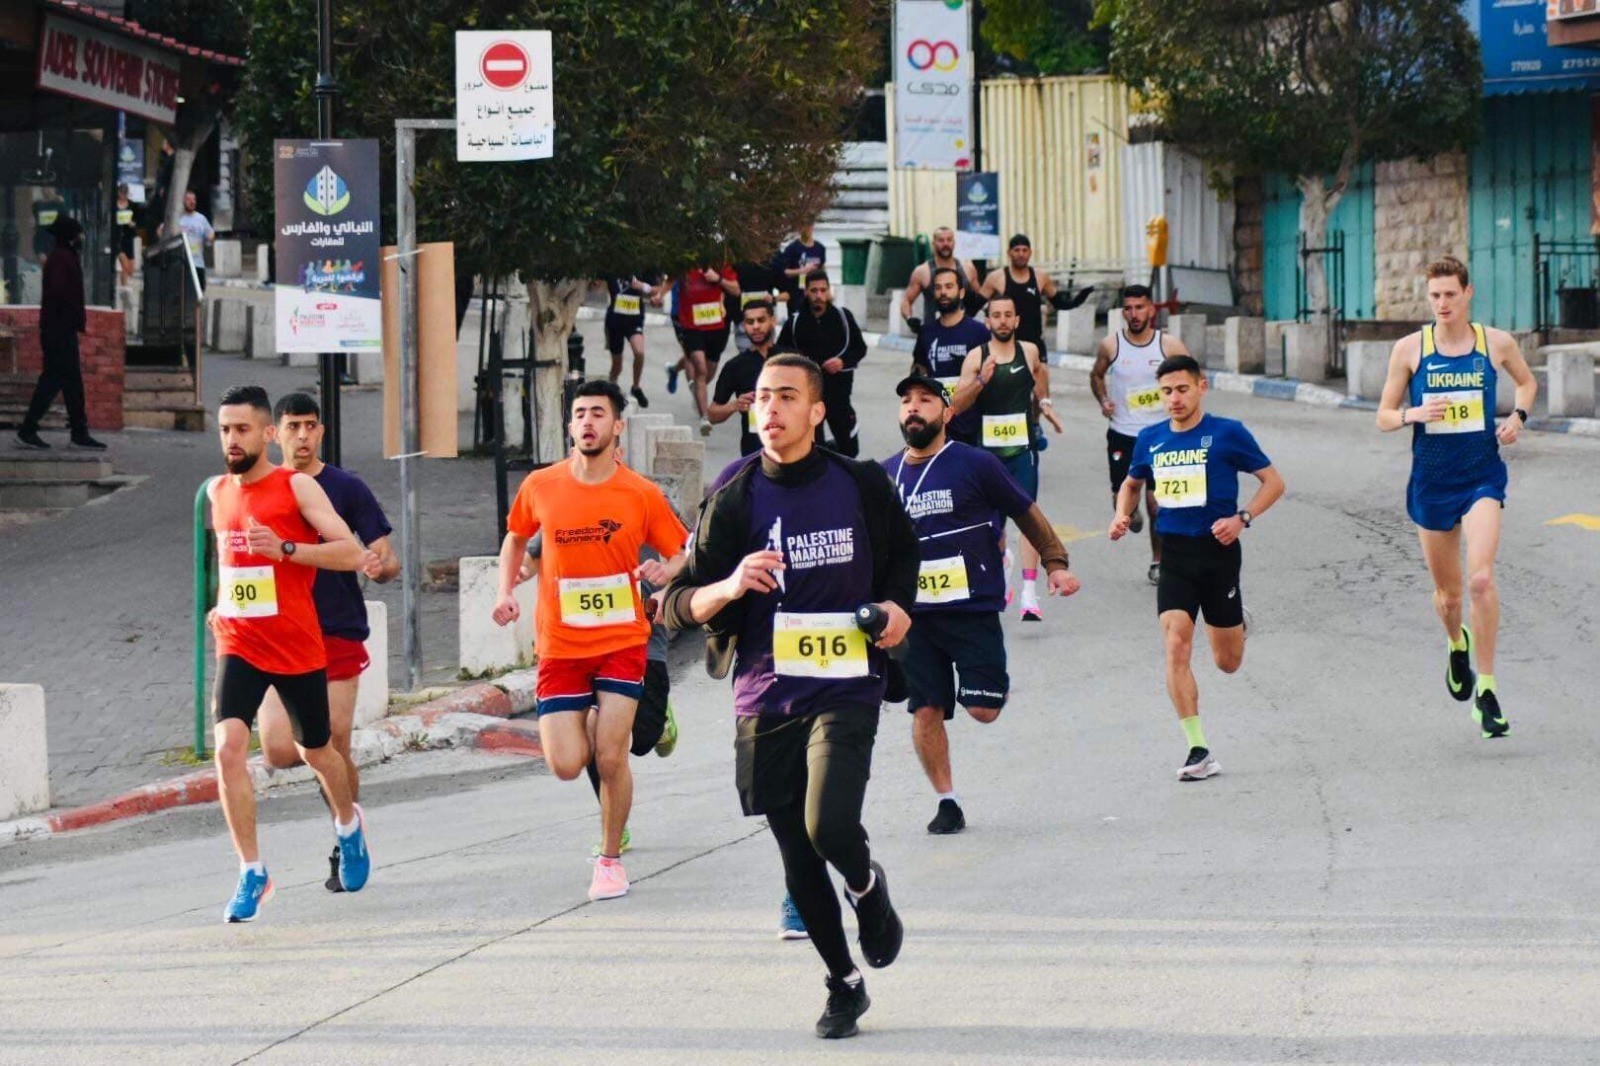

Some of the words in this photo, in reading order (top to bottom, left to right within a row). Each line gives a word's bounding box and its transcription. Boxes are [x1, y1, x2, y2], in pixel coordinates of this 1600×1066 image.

[43, 29, 78, 80] ADEL
[281, 221, 331, 236] والفارس
[1427, 372, 1484, 388] UKRAINE
[1138, 392, 1160, 405] 694
[993, 425, 1016, 436] 640
[1153, 448, 1208, 468] UKRAINE
[1162, 480, 1189, 495] 721
[555, 526, 605, 537] Freedom
[555, 534, 601, 545] Runners
[786, 527, 854, 550] PALESTINE
[790, 541, 854, 563] MARATHON
[918, 574, 951, 590] 812
[580, 593, 614, 610] 561
[799, 635, 847, 656] 616
